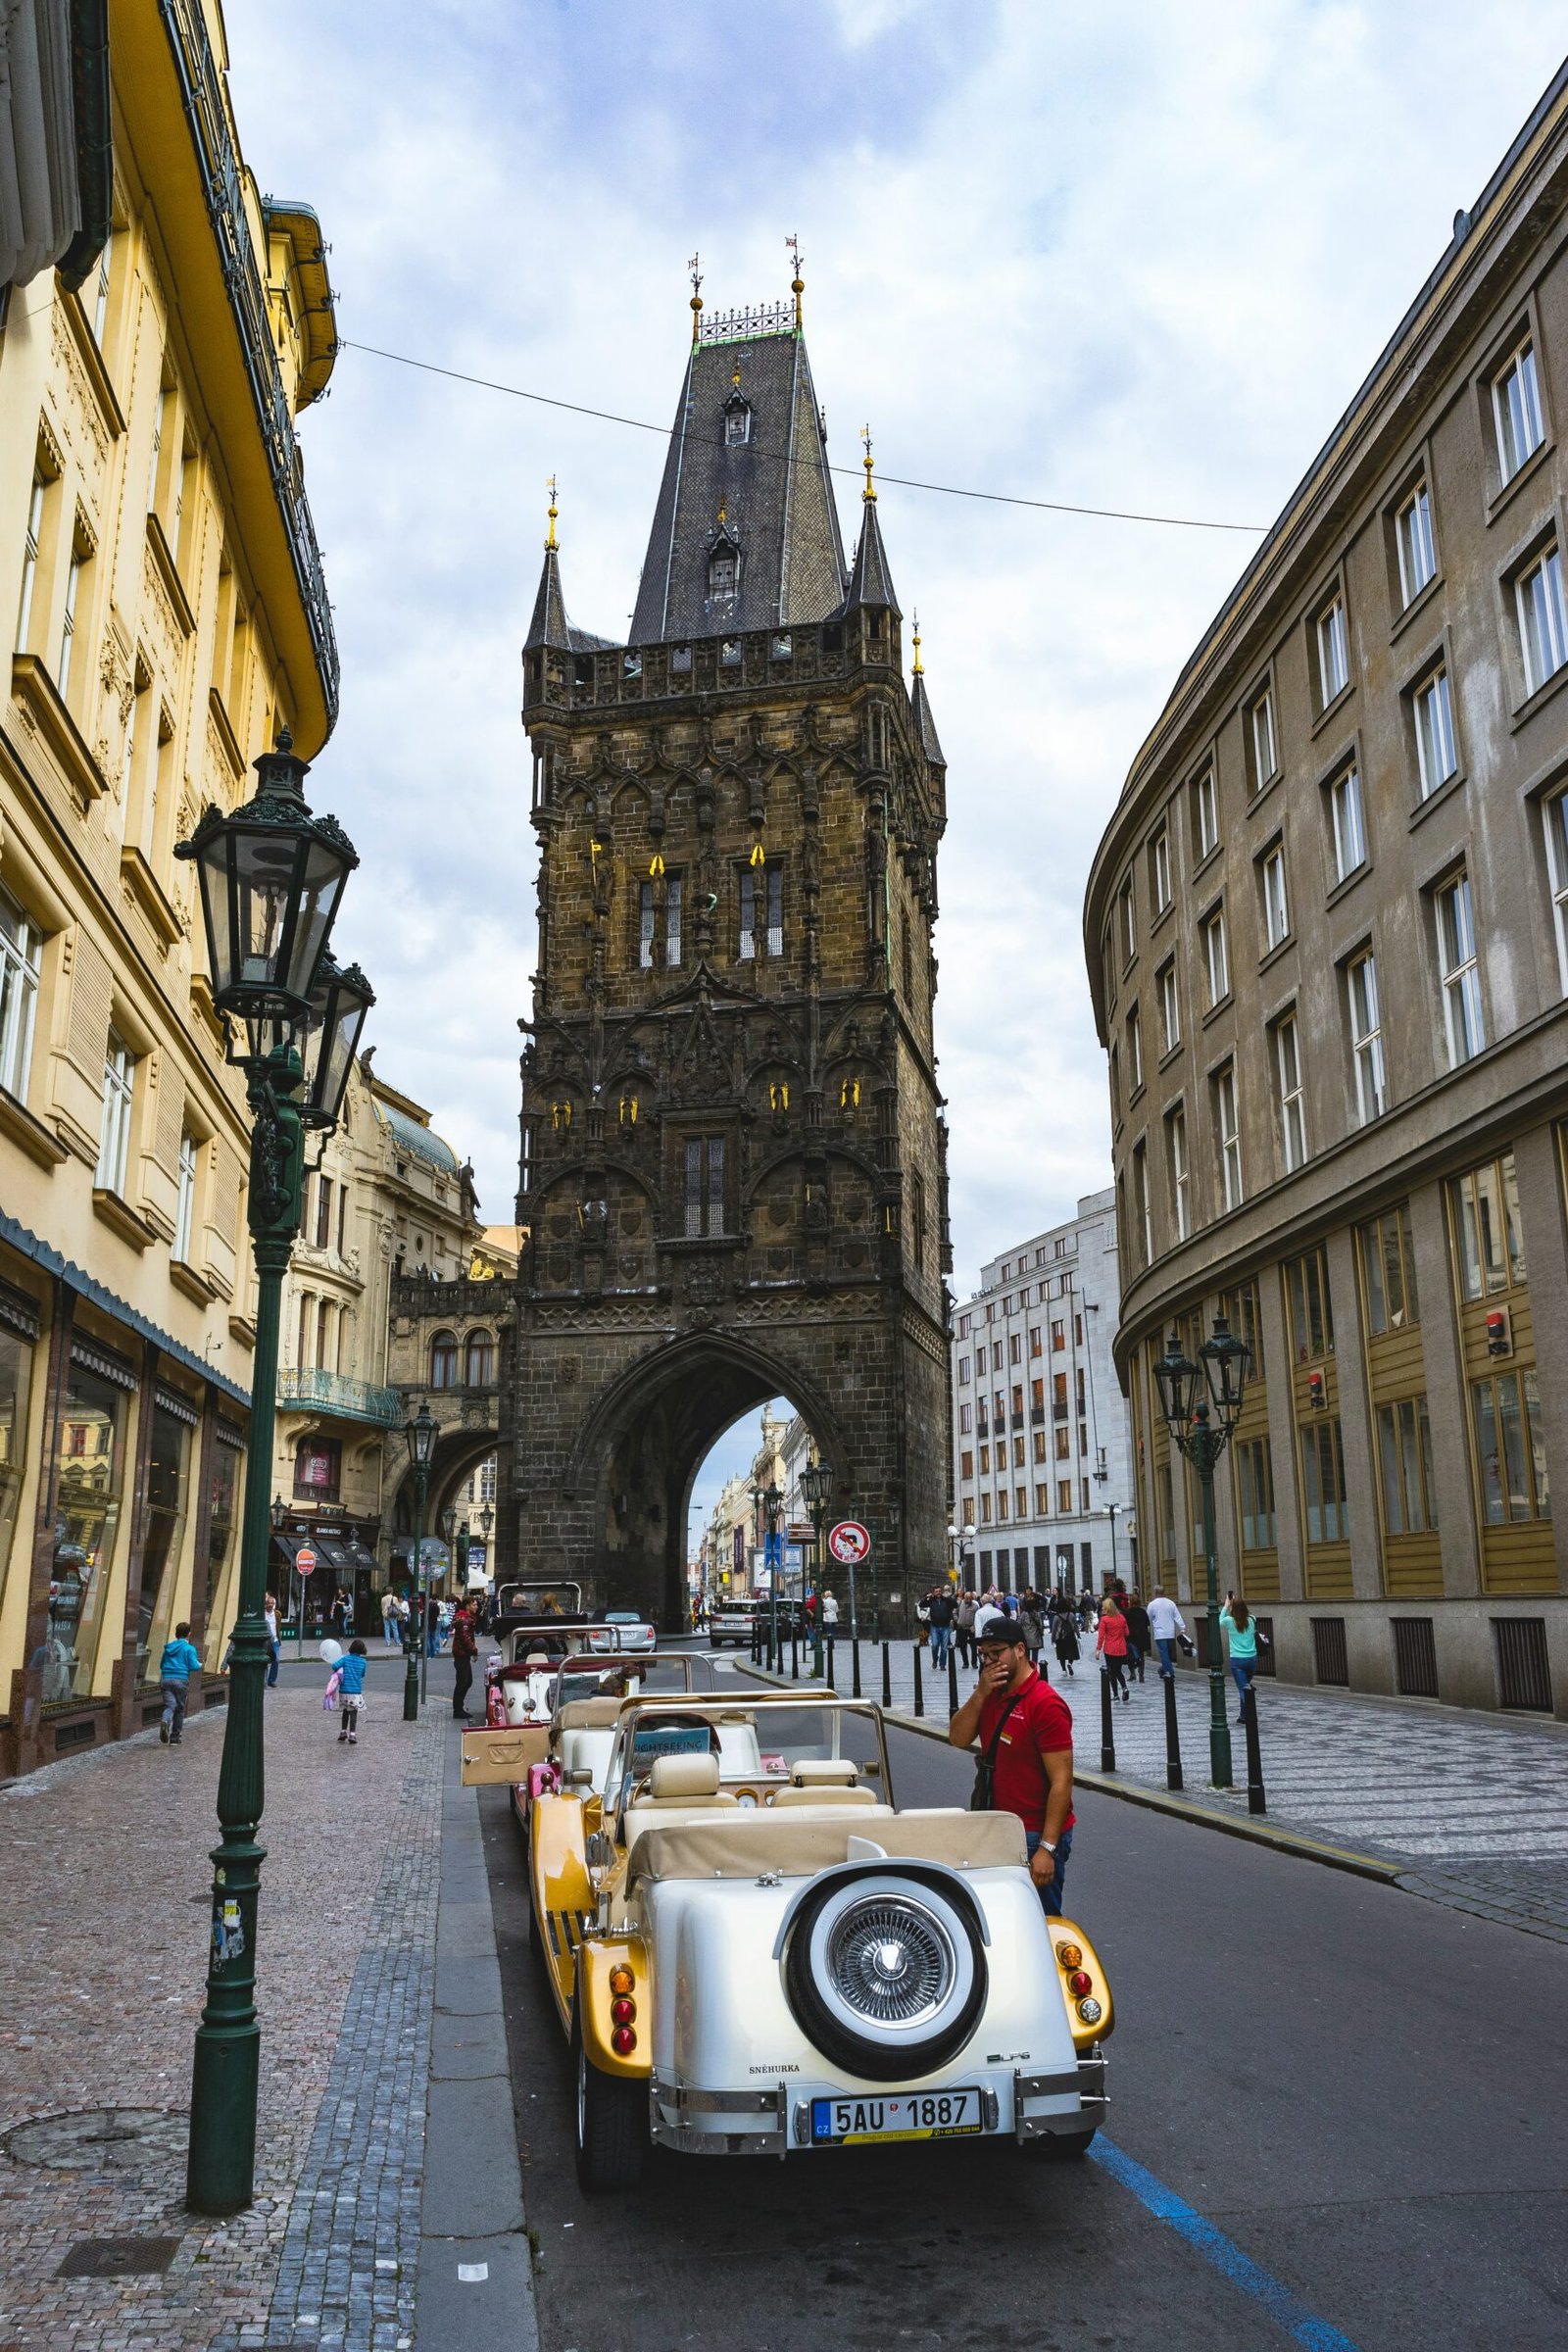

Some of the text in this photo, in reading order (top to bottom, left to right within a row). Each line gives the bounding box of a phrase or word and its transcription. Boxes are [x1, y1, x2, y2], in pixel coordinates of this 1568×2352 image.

[635, 1740, 703, 1752] IGHTSEEING
[836, 2096, 966, 2132] 5AU 1887
[816, 2125, 829, 2134] CZ
